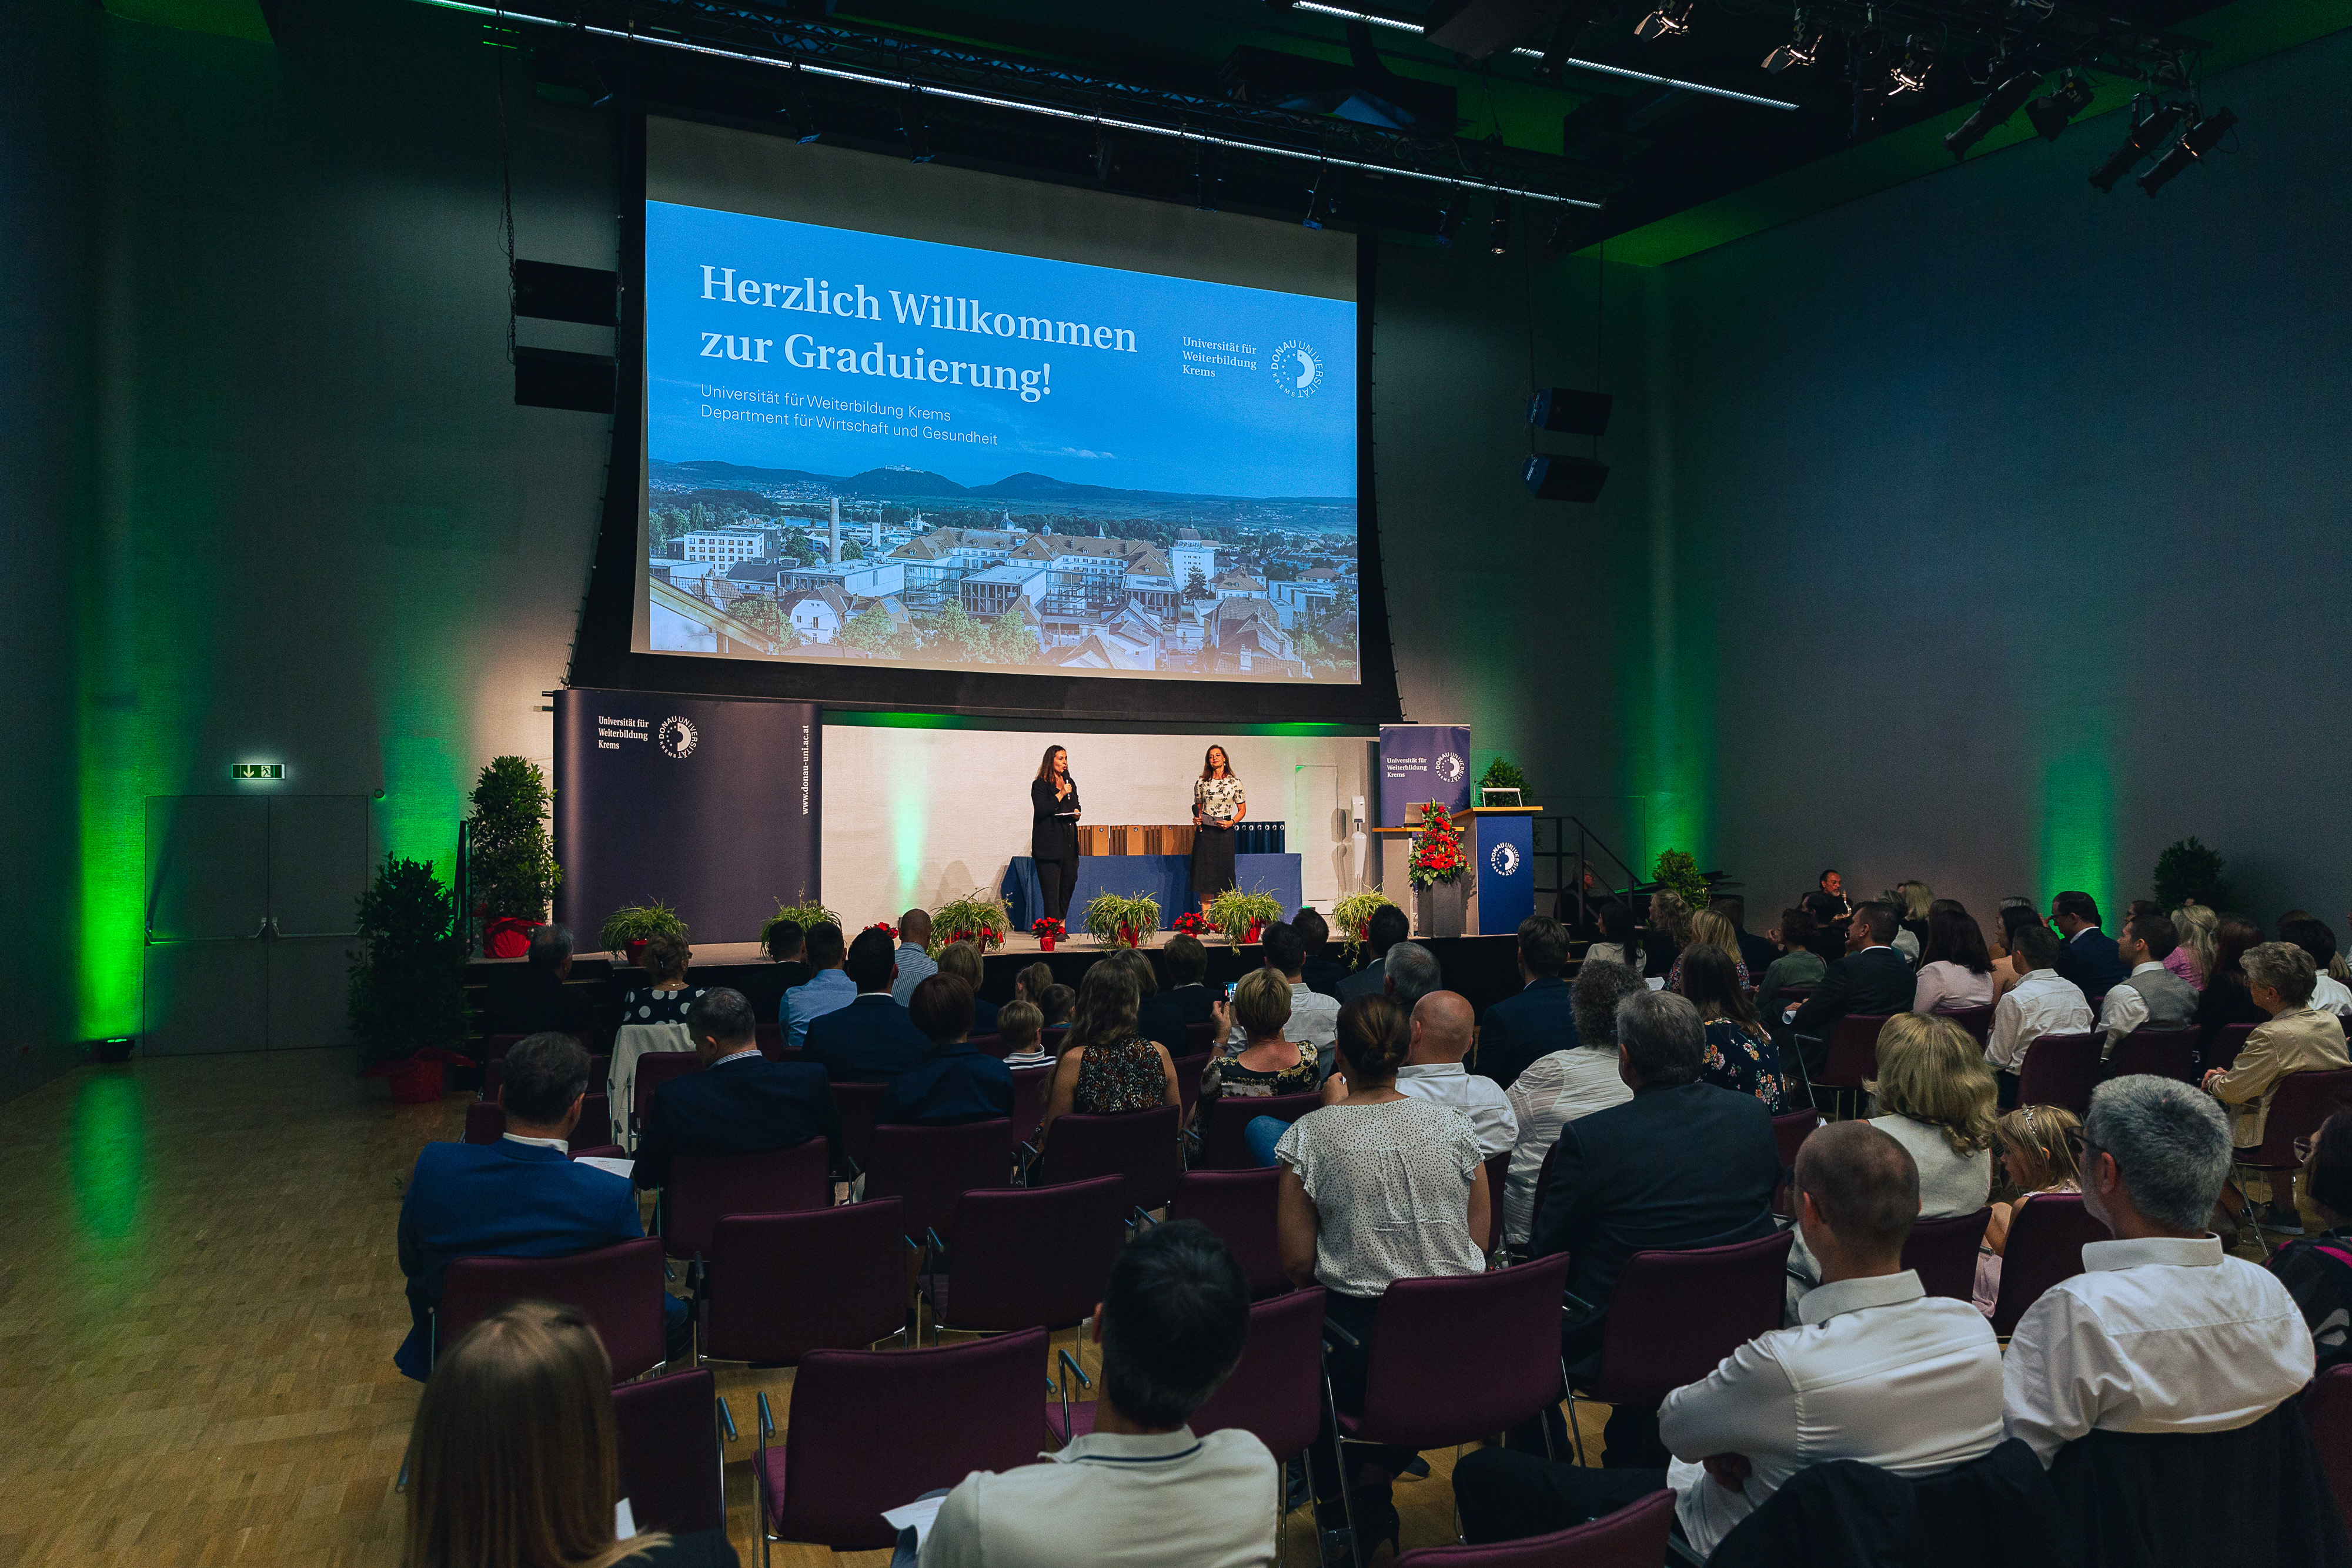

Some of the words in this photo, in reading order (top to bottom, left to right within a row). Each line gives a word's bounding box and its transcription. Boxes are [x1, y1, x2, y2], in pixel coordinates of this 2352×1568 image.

[700, 265, 881, 320] Herzlich
[888, 290, 1138, 353] Willkommen
[1182, 336, 1240, 353] Universität
[1241, 343, 1257, 354] für
[700, 332, 773, 363] zur
[784, 333, 1051, 403] Graduierung!
[1182, 350, 1257, 371] Weiterbildung
[1182, 365, 1216, 377] Krems
[1271, 340, 1297, 370] DONAU
[1297, 340, 1324, 398] UNIVERSITÄT
[1272, 373, 1295, 397] KREMS
[701, 383, 780, 404] Universität
[784, 392, 804, 407] für
[807, 394, 904, 419] Weiterbildung
[908, 405, 951, 421] Krems
[701, 404, 789, 426] Department
[793, 413, 814, 428] für
[816, 416, 889, 435] Wirtschaft
[893, 425, 918, 437] und
[923, 427, 998, 445] Gesundheit
[599, 716, 636, 727] Universität
[637, 718, 649, 728] für
[598, 728, 649, 741] Weiterbildung
[598, 740, 620, 750] Krems
[659, 716, 677, 739] DONAU
[677, 716, 698, 758] UNIVERSITÄT
[660, 741, 676, 758] KREMS
[801, 725, 809, 815] www.donau-uni.ac.at
[1435, 752, 1450, 770] DONAU
[1491, 842, 1505, 862] DONAU
